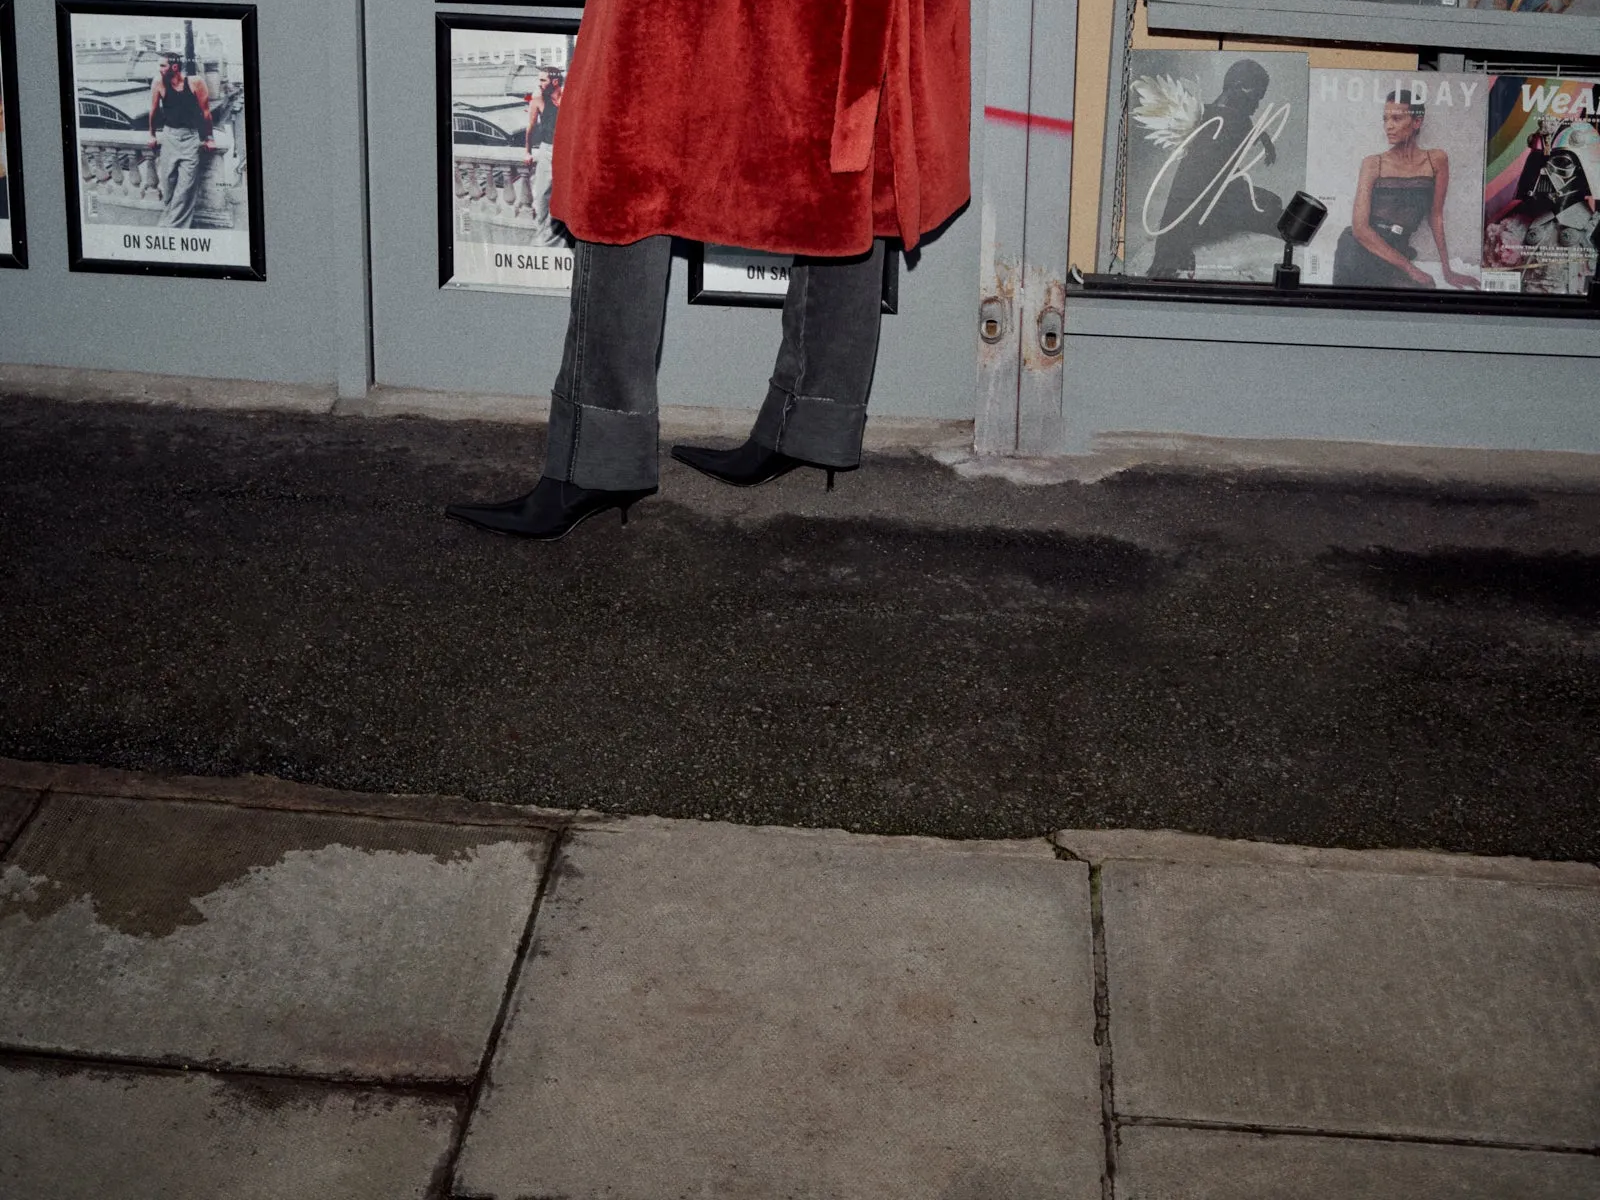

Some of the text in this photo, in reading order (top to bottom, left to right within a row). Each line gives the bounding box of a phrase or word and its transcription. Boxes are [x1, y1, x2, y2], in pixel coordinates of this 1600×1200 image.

[1320, 76, 1479, 108] HOLIDAY
[1521, 83, 1600, 115] WeA
[123, 234, 211, 252] ON SALE NOW
[495, 253, 572, 271] ON SALE NO
[746, 264, 765, 280] ON
